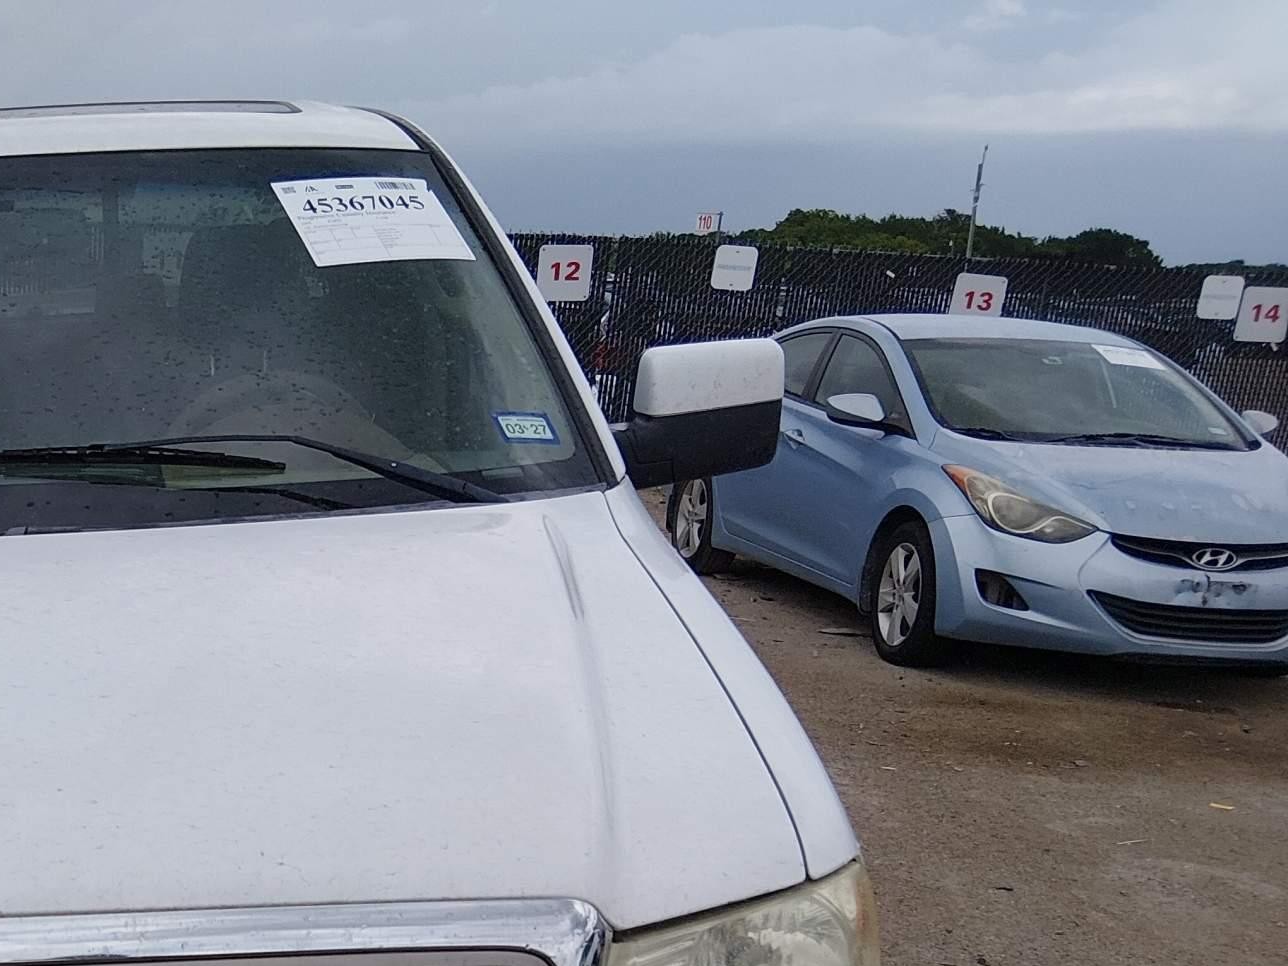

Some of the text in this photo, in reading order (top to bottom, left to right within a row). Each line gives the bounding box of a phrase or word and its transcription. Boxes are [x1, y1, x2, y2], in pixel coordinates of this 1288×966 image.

[302, 194, 425, 213] 45367045
[698, 214, 713, 230] 110
[550, 261, 581, 281] 12
[964, 290, 994, 311] 13
[1252, 303, 1280, 323] 14
[505, 423, 547, 435] 03 27
